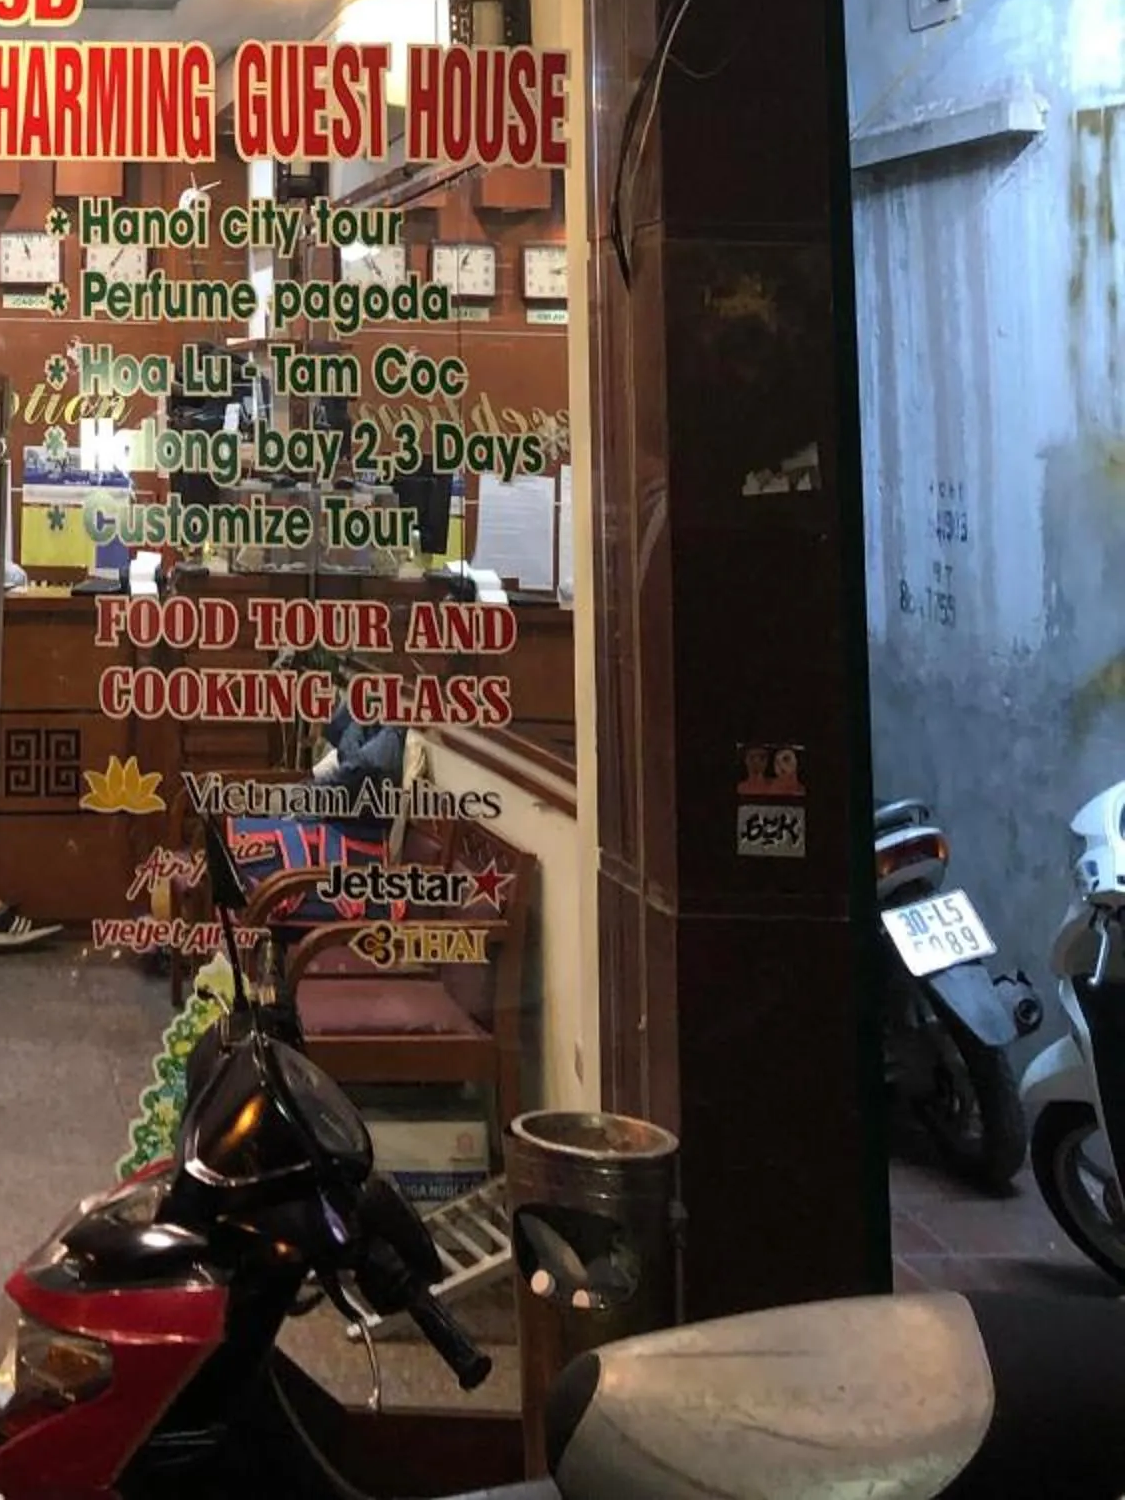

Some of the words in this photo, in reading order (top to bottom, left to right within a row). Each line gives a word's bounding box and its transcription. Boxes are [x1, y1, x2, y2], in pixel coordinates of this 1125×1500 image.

[235, 40, 390, 163] GUEST
[406, 43, 571, 165] HOUSE
[78, 197, 210, 250] Hanoi
[219, 203, 311, 258] city
[316, 203, 404, 249] tour
[78, 271, 258, 322] Perfume
[273, 271, 452, 334] pagoda
[79, 344, 171, 399] Hoa
[182, 344, 232, 399] Lu
[268, 345, 360, 399] Tam
[372, 343, 470, 399] Coc
[255, 418, 345, 482] bay
[351, 421, 420, 483] 2,3
[432, 422, 545, 484] Days
[81, 491, 315, 549] Customize
[321, 496, 420, 550] Tour
[94, 595, 239, 649] FOOD
[248, 597, 393, 652] TOUR
[405, 601, 518, 655] AND
[99, 666, 335, 723] COOKING
[347, 671, 513, 728] CLASS
[181, 771, 352, 818] Vietnam
[351, 775, 503, 820] Airlines
[317, 860, 469, 906] Jetstar
[404, 928, 492, 965] THAI
